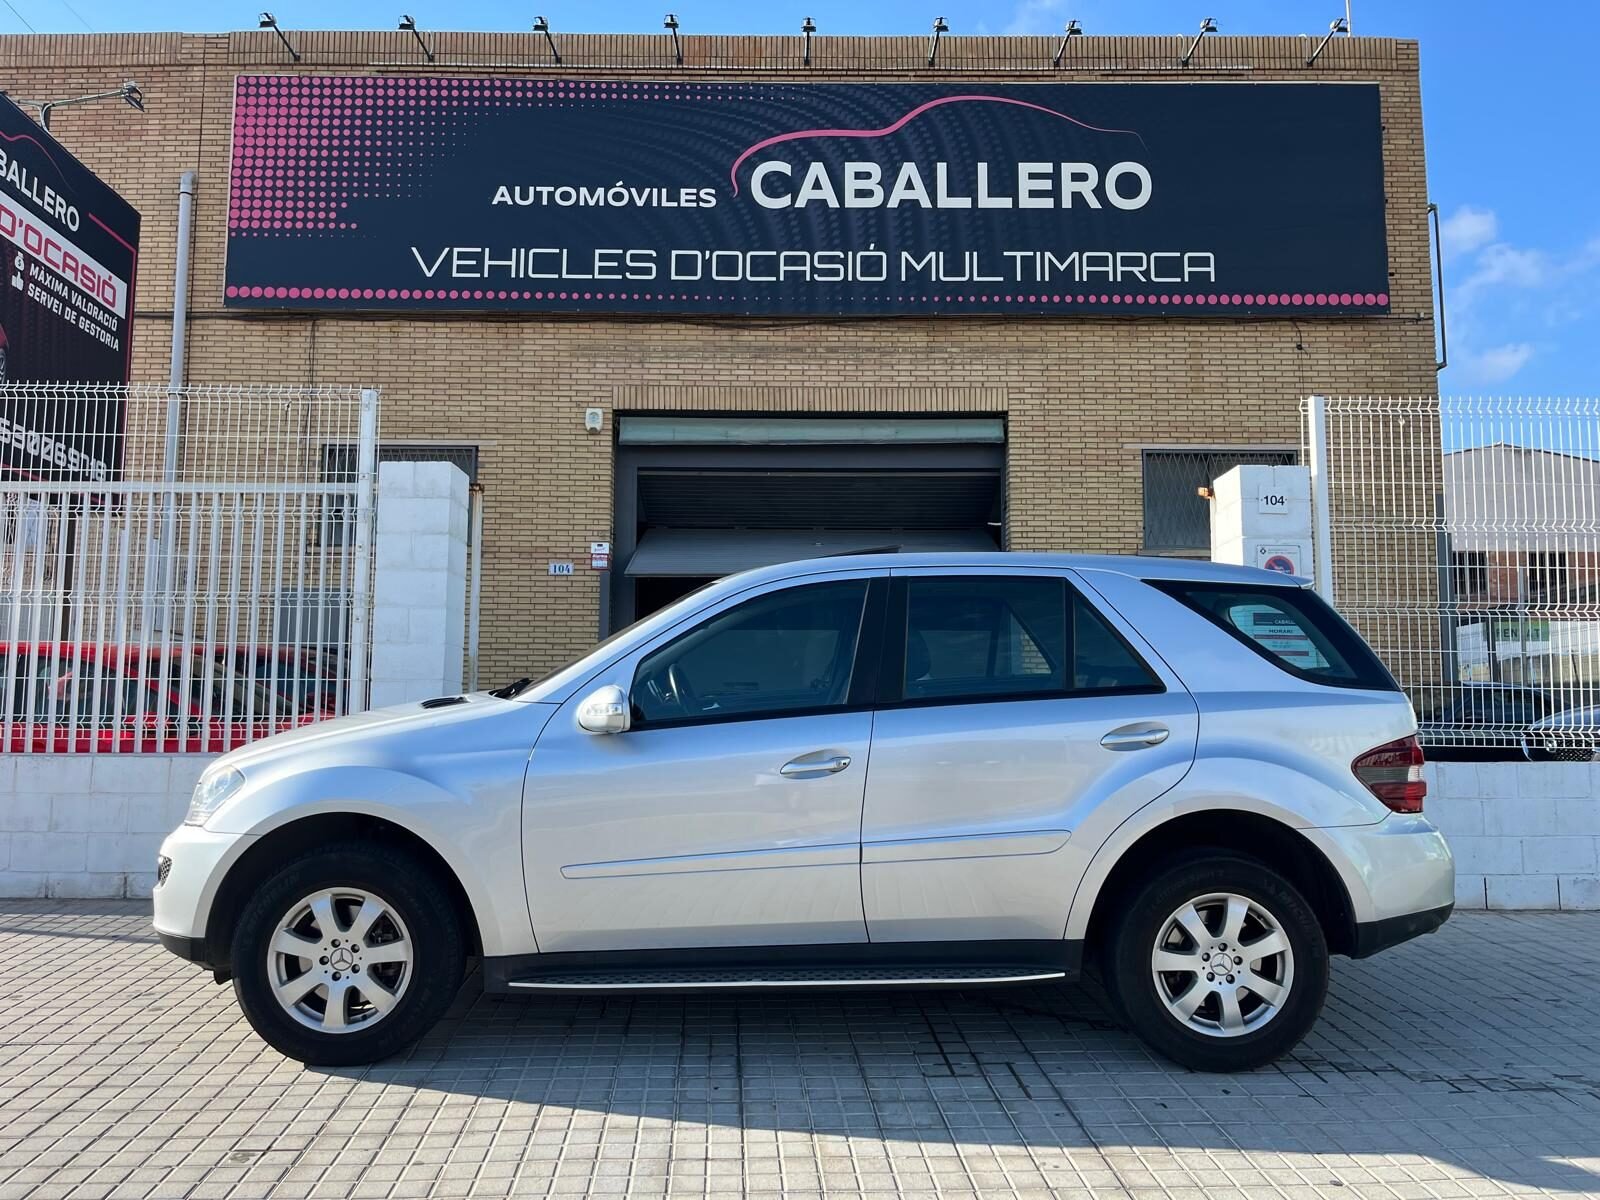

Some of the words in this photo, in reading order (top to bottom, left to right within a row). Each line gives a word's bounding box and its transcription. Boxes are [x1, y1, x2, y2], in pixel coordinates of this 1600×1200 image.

[492, 181, 717, 208] AUTOMÓVILES
[750, 160, 1153, 211] CABALLERO
[410, 246, 657, 281] VEHICLES
[671, 243, 888, 282] D'OCASIÓ
[901, 251, 1216, 283] MULTIMARCA
[27, 283, 63, 316] SERVEI
[64, 307, 77, 325] DE
[78, 315, 119, 352] GESTORIA
[30, 263, 69, 300] MÀXIMA
[71, 290, 119, 332] VALORACIÓ
[1263, 495, 1285, 506] 104
[553, 564, 570, 574] 104
